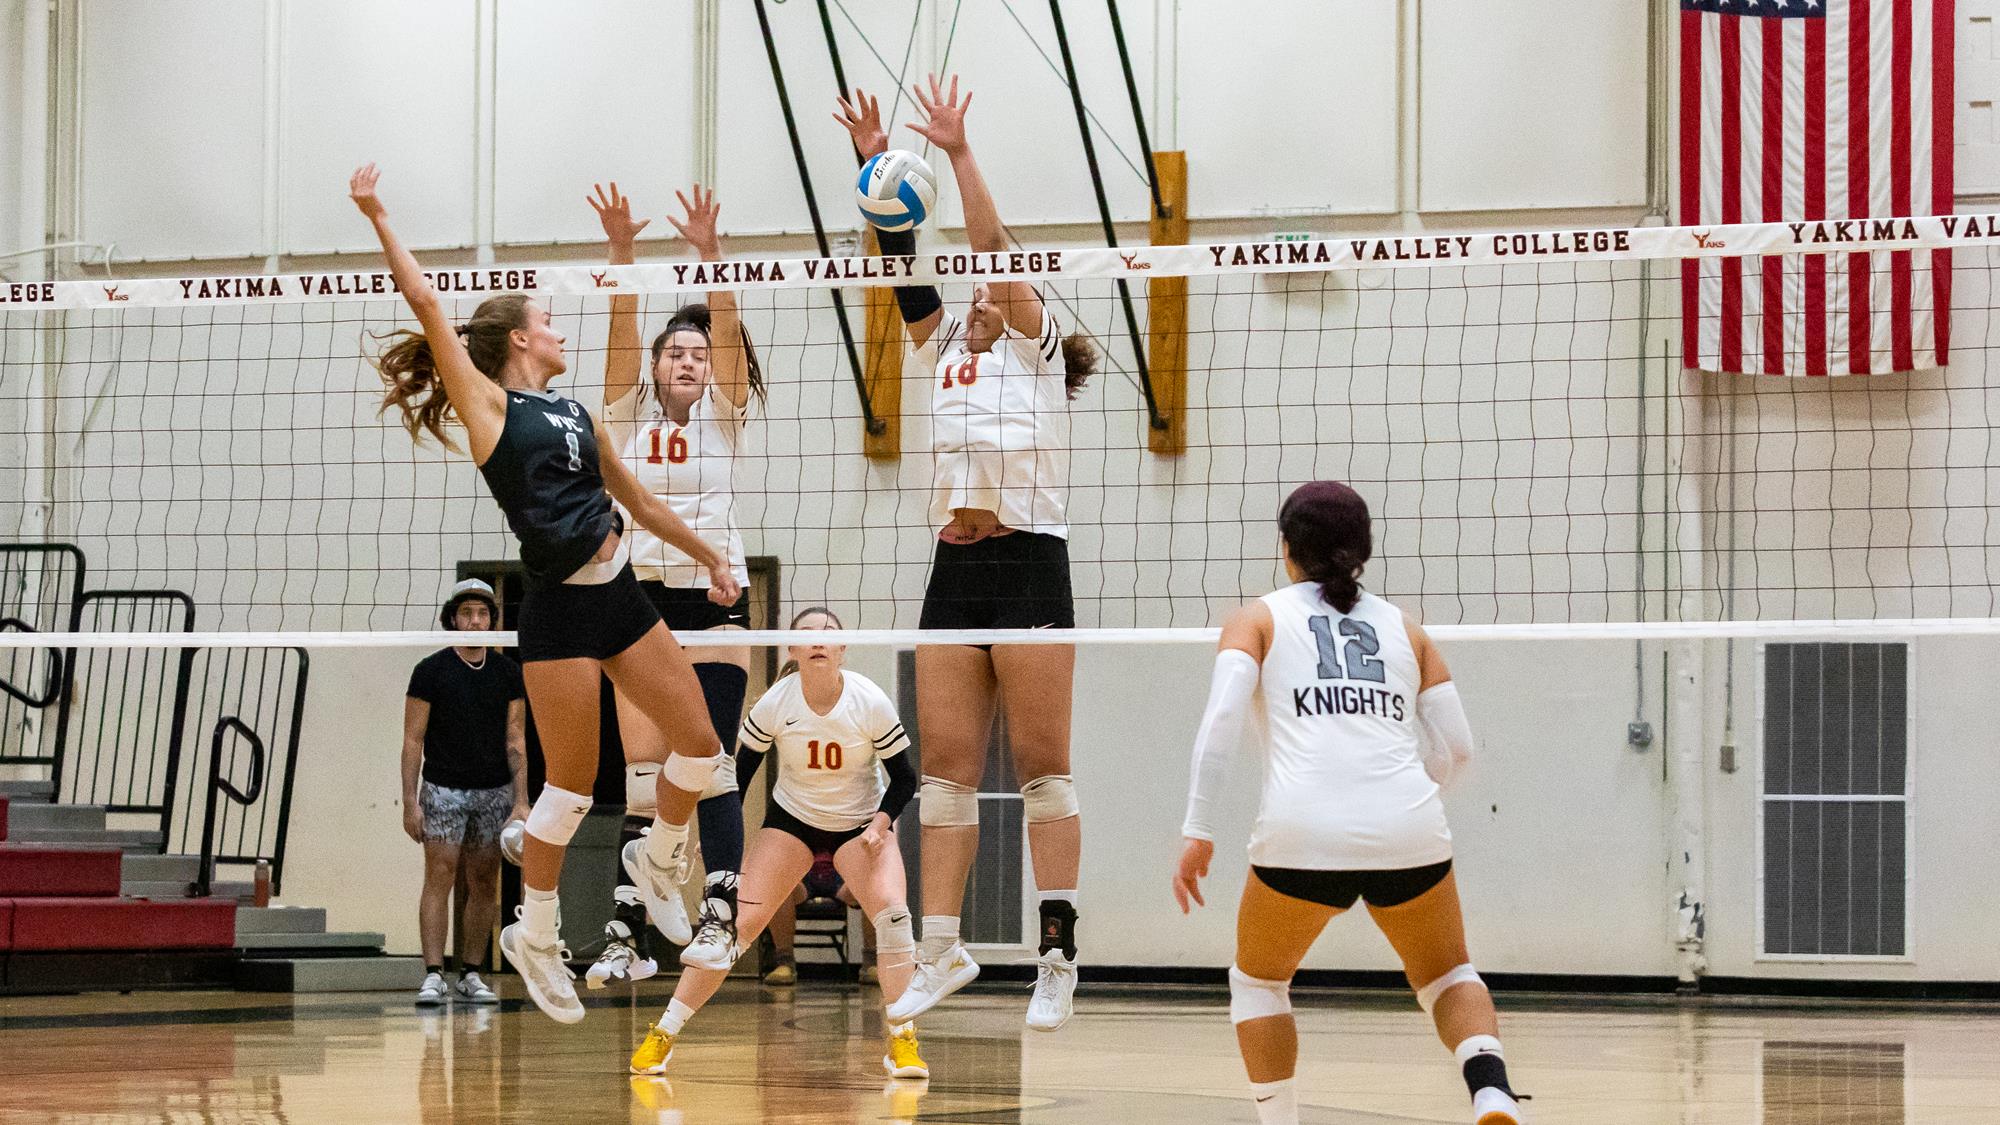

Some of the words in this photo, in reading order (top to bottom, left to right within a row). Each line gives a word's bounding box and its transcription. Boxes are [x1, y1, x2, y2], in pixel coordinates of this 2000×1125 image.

[1789, 217, 1918, 243] YAKIMA
[1940, 215, 2000, 238] VAL
[1209, 242, 1331, 267] YAKIMA
[1350, 236, 1472, 261] VALLEY
[1493, 231, 1630, 256] COLLEGE
[180, 277, 283, 299] YAKIMA
[423, 269, 537, 292] OLLEGE
[672, 262, 785, 284] YAKIMA
[803, 257, 917, 280] VALLEY
[934, 252, 1062, 275] COLLEGE
[543, 411, 583, 432] WVC
[565, 432, 582, 471] 1
[646, 428, 687, 464] 16
[1308, 615, 1385, 684] 12
[1293, 686, 1405, 722] KNIGHTS
[807, 739, 842, 770] 10
